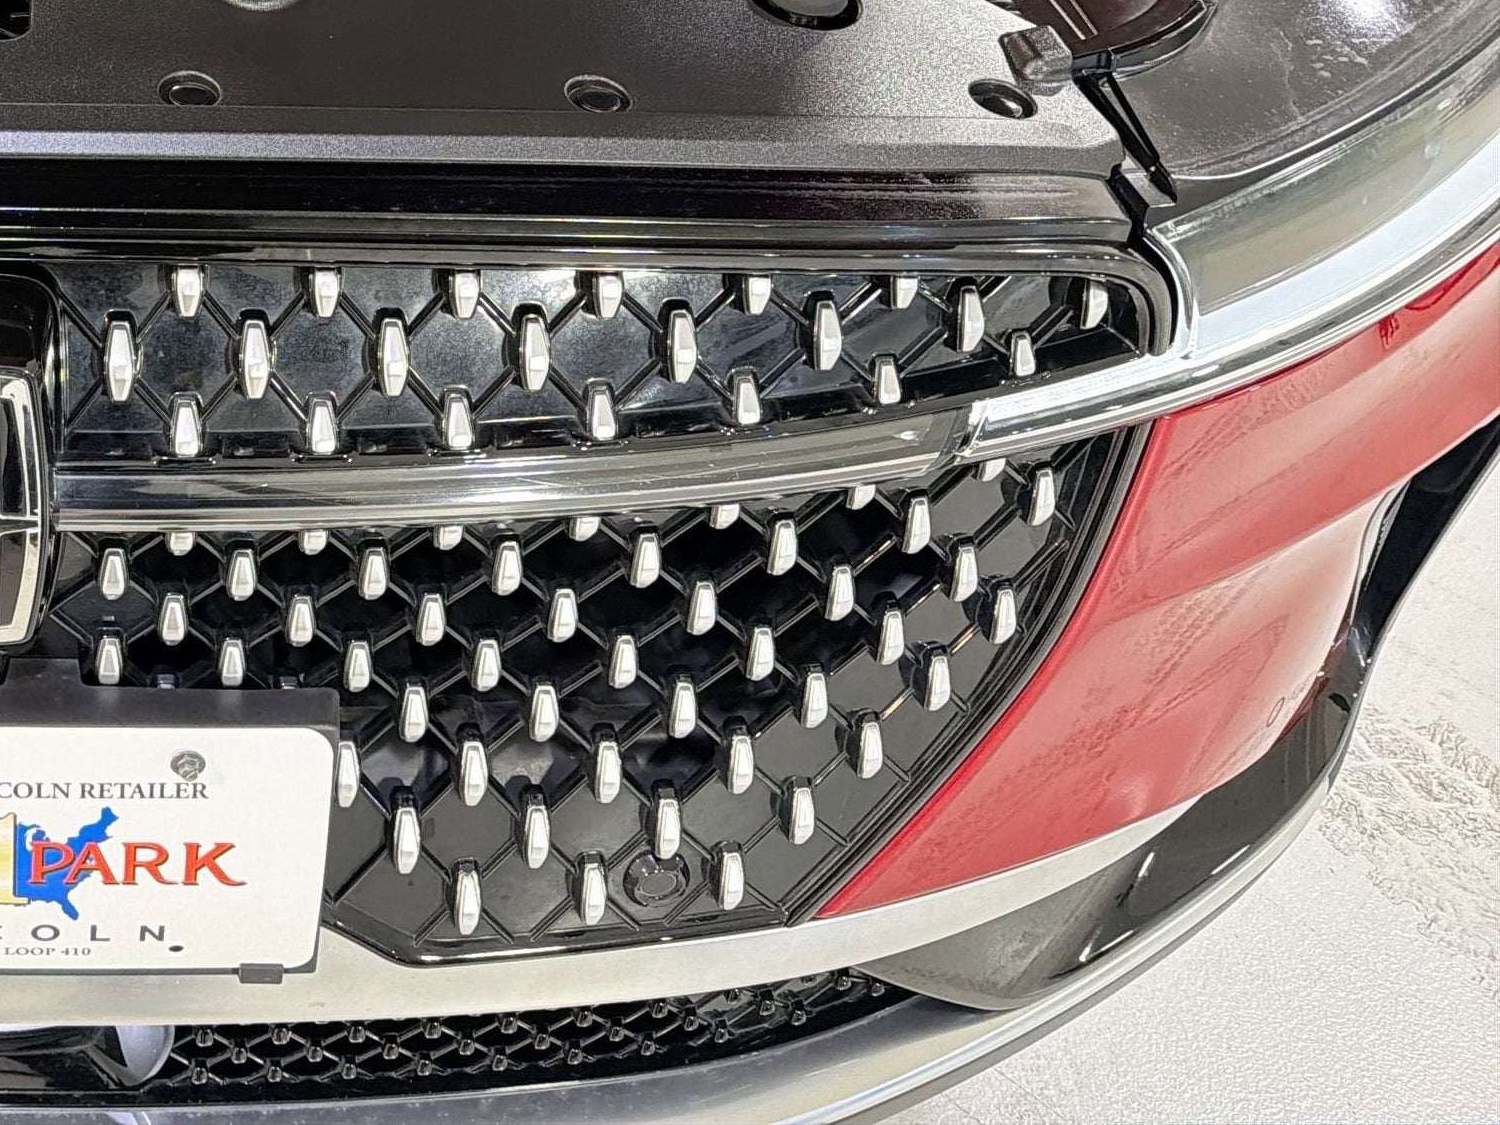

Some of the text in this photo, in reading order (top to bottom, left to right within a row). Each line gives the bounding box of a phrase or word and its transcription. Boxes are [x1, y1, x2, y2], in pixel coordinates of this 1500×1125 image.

[78, 782, 210, 799] RETAILER
[28, 841, 248, 887] PARK
[4, 947, 56, 956] LOOP
[60, 947, 92, 956] 410
